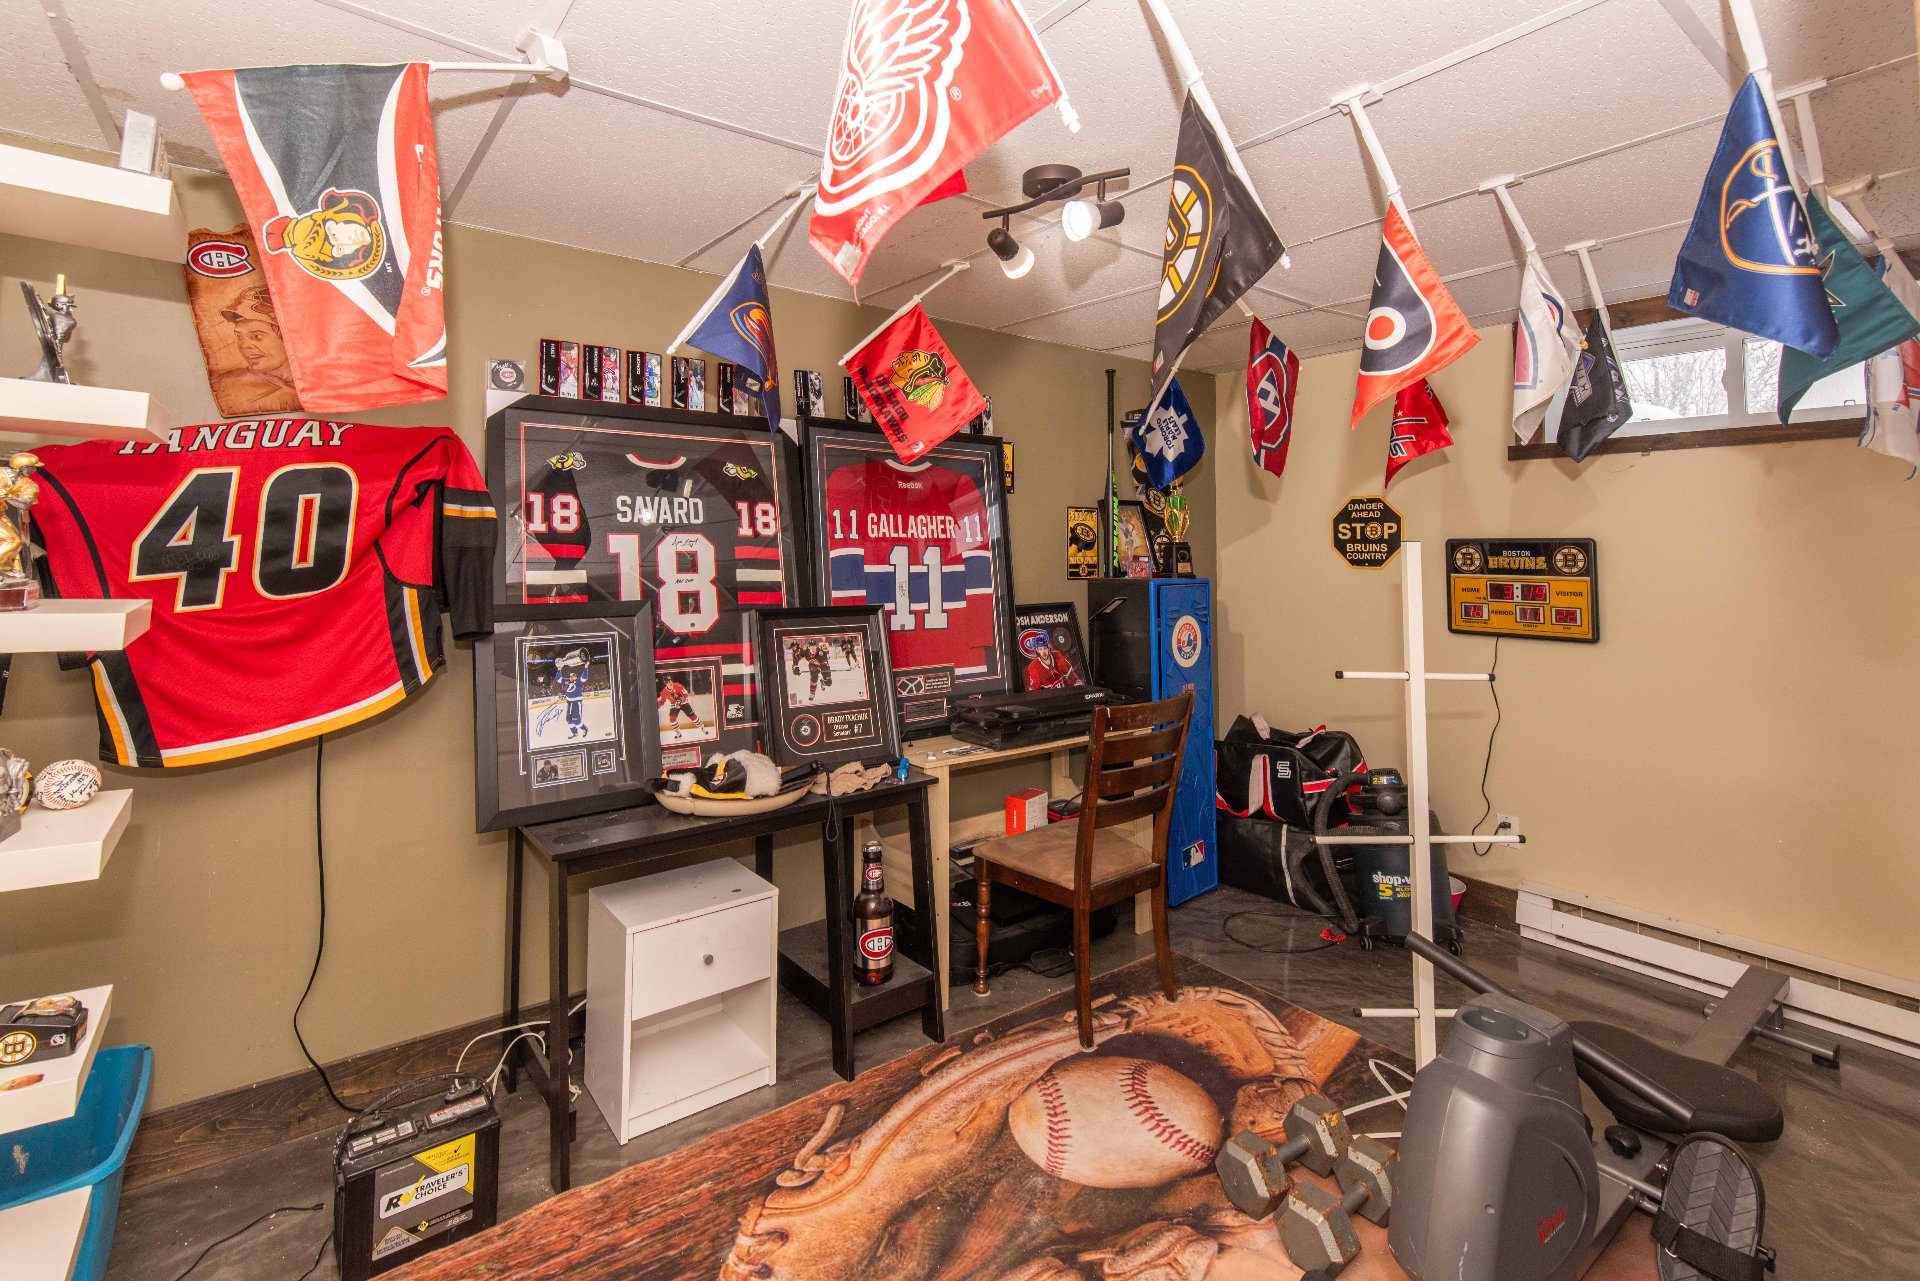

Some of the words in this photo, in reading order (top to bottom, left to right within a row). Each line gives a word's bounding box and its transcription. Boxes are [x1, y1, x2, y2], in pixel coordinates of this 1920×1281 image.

[858, 364, 909, 443] BLACKHAWKS
[875, 374, 909, 422] CHICAGO
[1156, 418, 1175, 450] TORONTO
[1161, 417, 1178, 441] MAPLE
[1167, 415, 1182, 436] LEAFS
[897, 480, 924, 490] Reebok
[526, 492, 580, 534] 18
[616, 495, 704, 525] SAVARD
[1348, 502, 1384, 511] DANGER
[1351, 510, 1381, 519] AHEAD
[735, 500, 779, 538] 18
[832, 508, 860, 540] 11
[867, 512, 956, 539] GALLAGHER
[963, 515, 984, 543] 11
[128, 461, 360, 614] 40
[1337, 522, 1398, 540] STOP
[1346, 543, 1388, 552] BRUINS
[1346, 552, 1388, 560] COUNTRY
[1487, 556, 1548, 570] BRUINS
[606, 531, 721, 635] 18
[888, 544, 949, 632] 11
[1030, 612, 1068, 624] ANDERSON
[827, 714, 845, 724] BRADY
[853, 723, 863, 734] #7
[1379, 883, 1393, 897] 5
[414, 1182, 447, 1200] CHOICE
